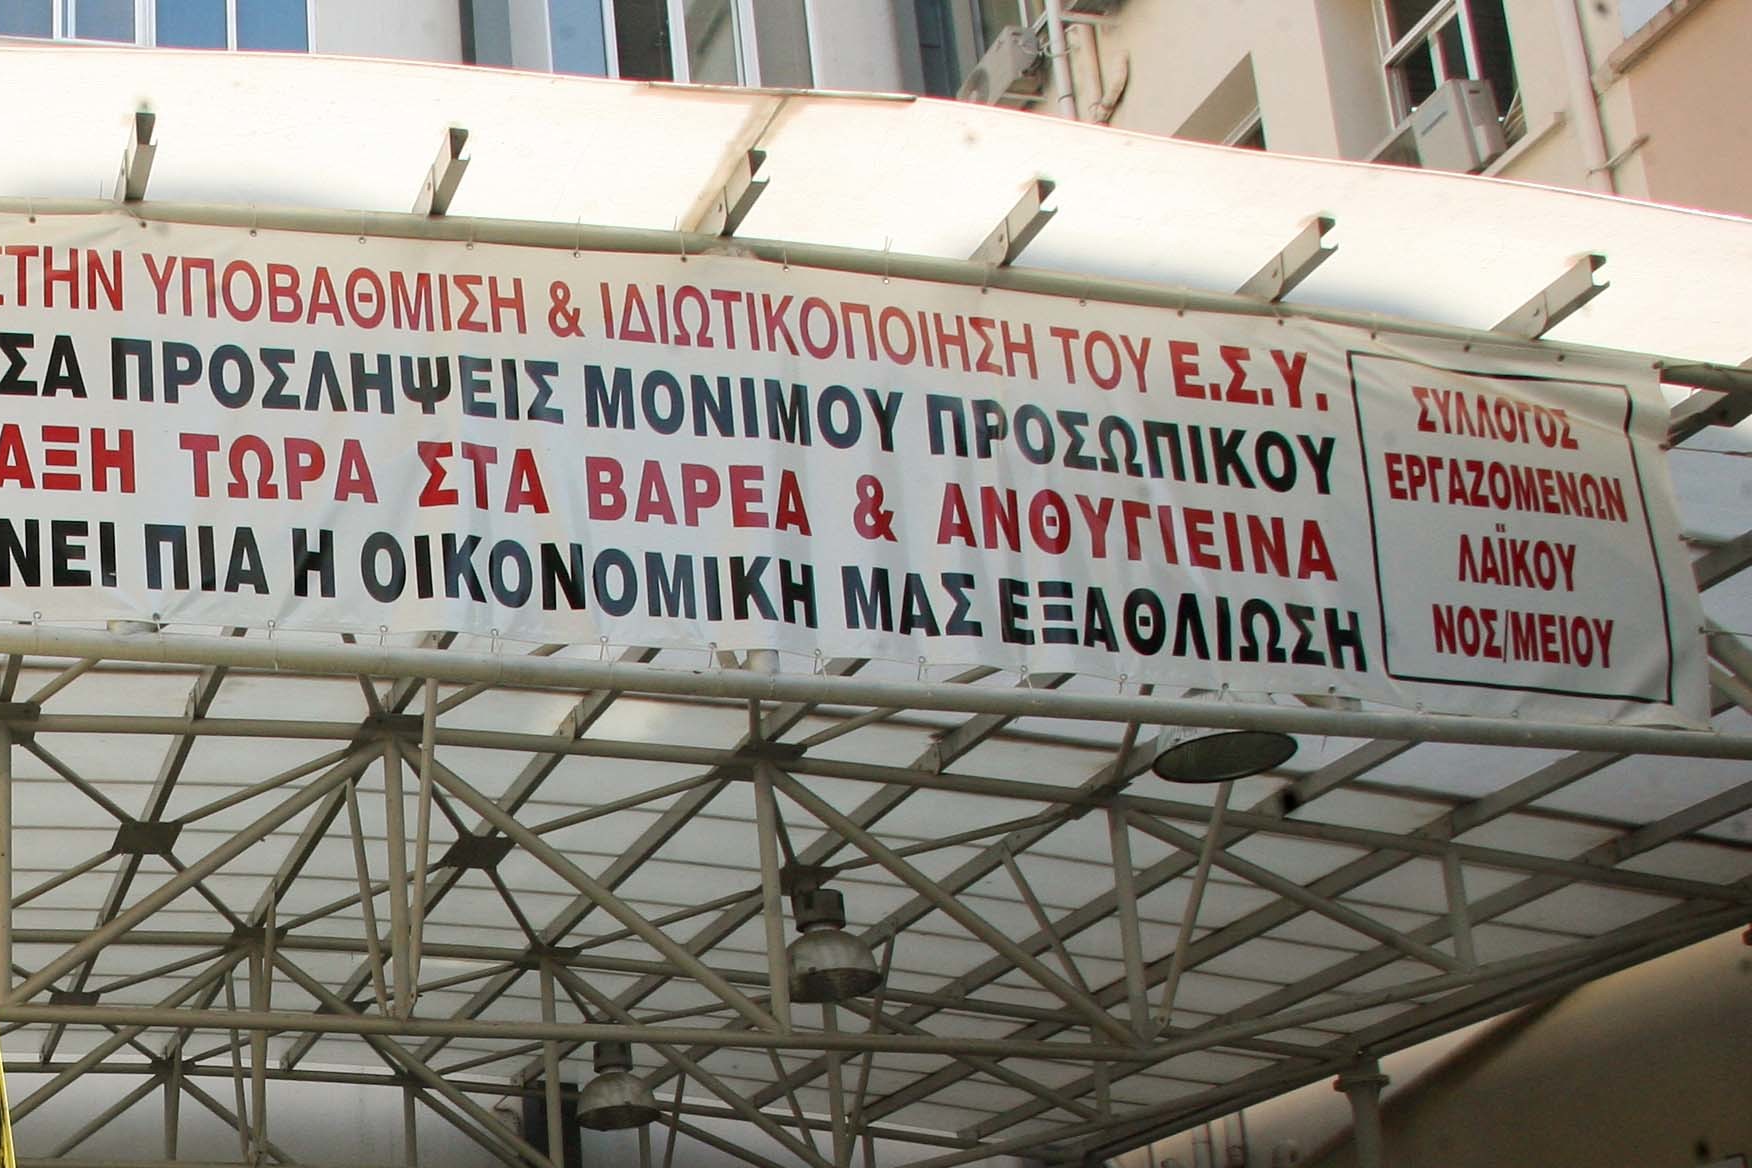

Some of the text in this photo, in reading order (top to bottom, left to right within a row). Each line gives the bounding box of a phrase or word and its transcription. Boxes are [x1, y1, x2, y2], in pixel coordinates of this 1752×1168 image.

[143, 254, 527, 334] ΥΠΟΒΑΘΜΙΣΗ
[548, 281, 584, 338] &
[601, 282, 1038, 379] ΙΔΙΩΤΙΚΟΠΟΙΗΣΗ
[1051, 326, 1151, 394] ΤΟΥ
[1169, 340, 1329, 412] Ε.Σ.Υ.
[111, 337, 564, 424] ΠΡΟΣΛΗΨΕΙΣ
[583, 364, 903, 453] ΜΟΝΙΜΟΥ
[926, 394, 1336, 496] ΠΡΟΣΩΠΙΚΟΥ
[1411, 385, 1580, 451] ΣΥΛΛΟΓΟΣ
[179, 432, 378, 503] ΤΩΡΑ
[417, 441, 550, 514] ΣΤΑ
[585, 456, 812, 537] ΒΑΡΕΑ
[853, 474, 898, 543] &
[937, 483, 1338, 582] ΑΝΘΥΓΙΕΙΝΑ
[1384, 452, 1629, 523] ΕΡΓΑΖΟΜΕΝΩΝ
[144, 523, 270, 595] ΠΙΑ
[292, 527, 336, 598] Η
[360, 531, 818, 629] ΟΙΚΟΝΟΜΙΚΗ
[841, 565, 983, 638] ΜΑΣ
[998, 578, 1368, 673] ΕΞΑΘΛΙΩΣΗ
[1458, 524, 1577, 593] ΛΑΪΚΟΥ
[1431, 603, 1615, 669] ΝΟΣ/ΜΕΙΟΥ
